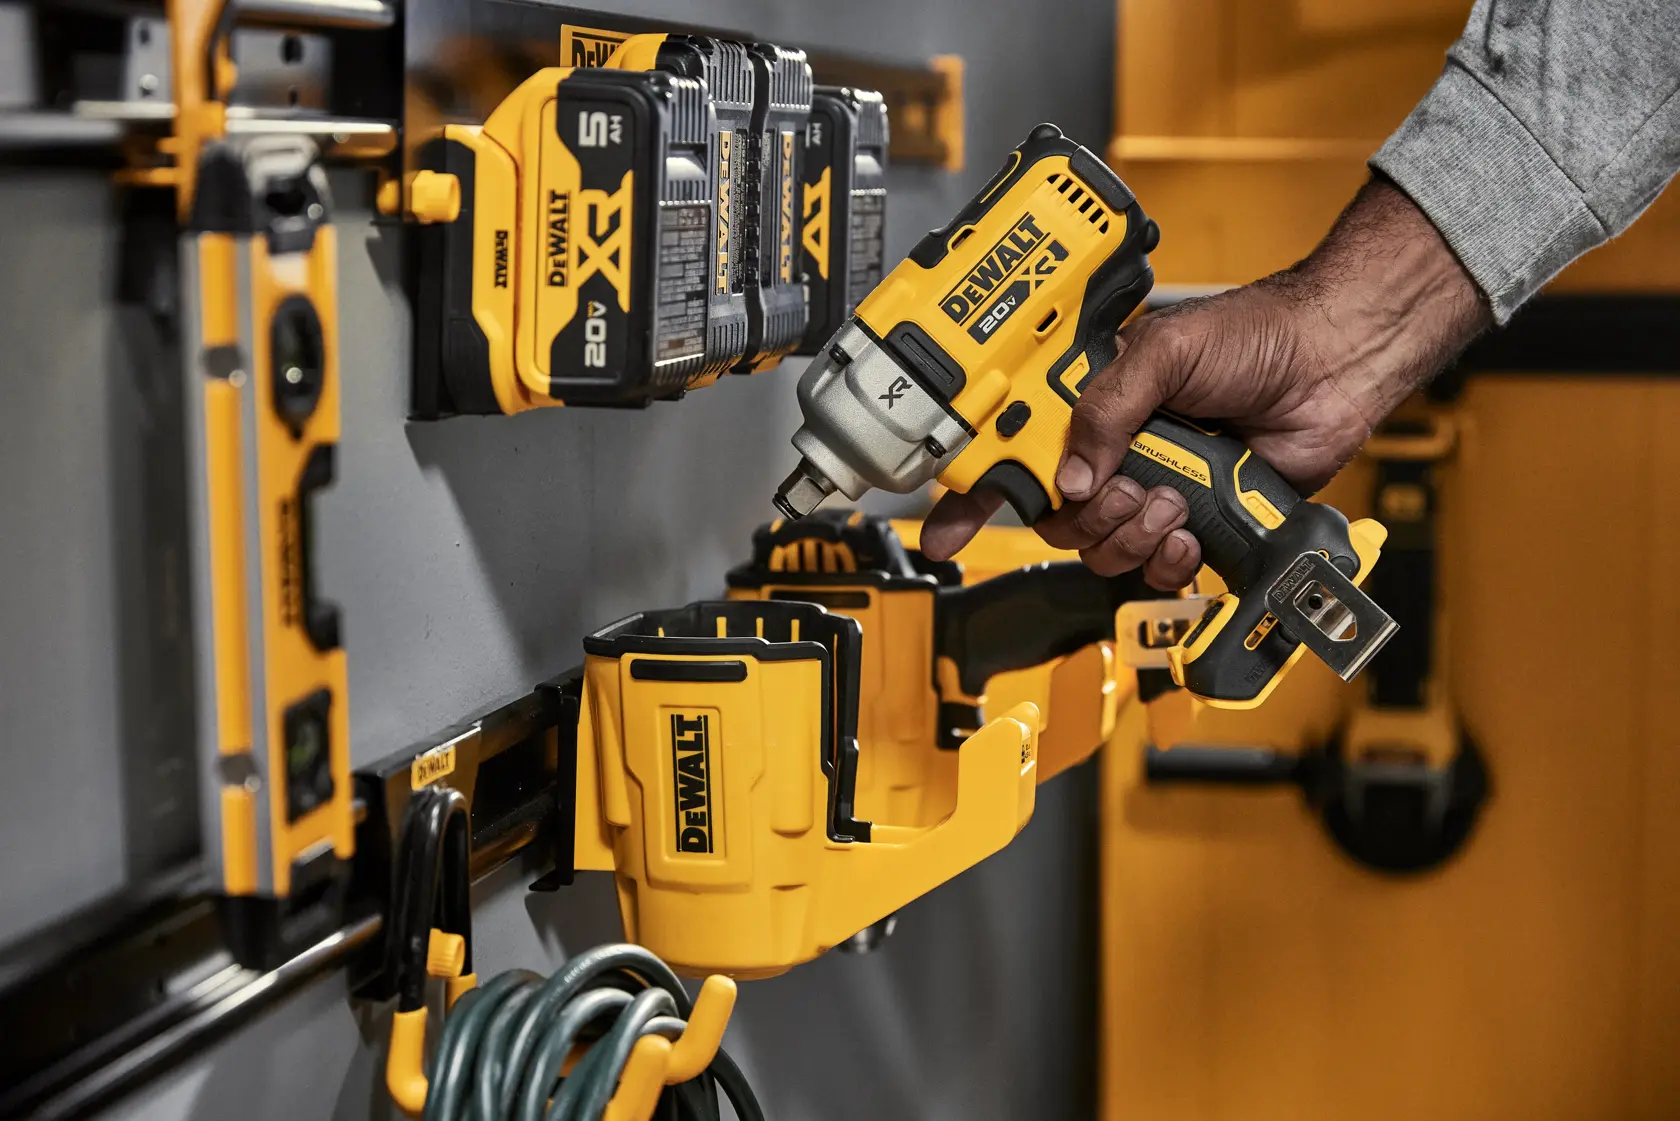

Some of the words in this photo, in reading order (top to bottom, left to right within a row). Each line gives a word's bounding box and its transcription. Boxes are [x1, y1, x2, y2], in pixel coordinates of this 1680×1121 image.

[578, 111, 608, 147] 5
[609, 115, 623, 144] AH
[548, 190, 568, 287] DEWALT
[577, 168, 633, 312] XR
[716, 131, 732, 295] DEWALT
[940, 213, 1045, 324] DEWALT
[1015, 246, 1065, 297] XR
[584, 301, 607, 367] 20V
[978, 295, 1017, 334] 20V
[878, 376, 912, 410] XR
[1133, 440, 1208, 482] BRUSHLESS
[1273, 558, 1316, 603] DEWALT
[675, 714, 708, 853] DEWALT
